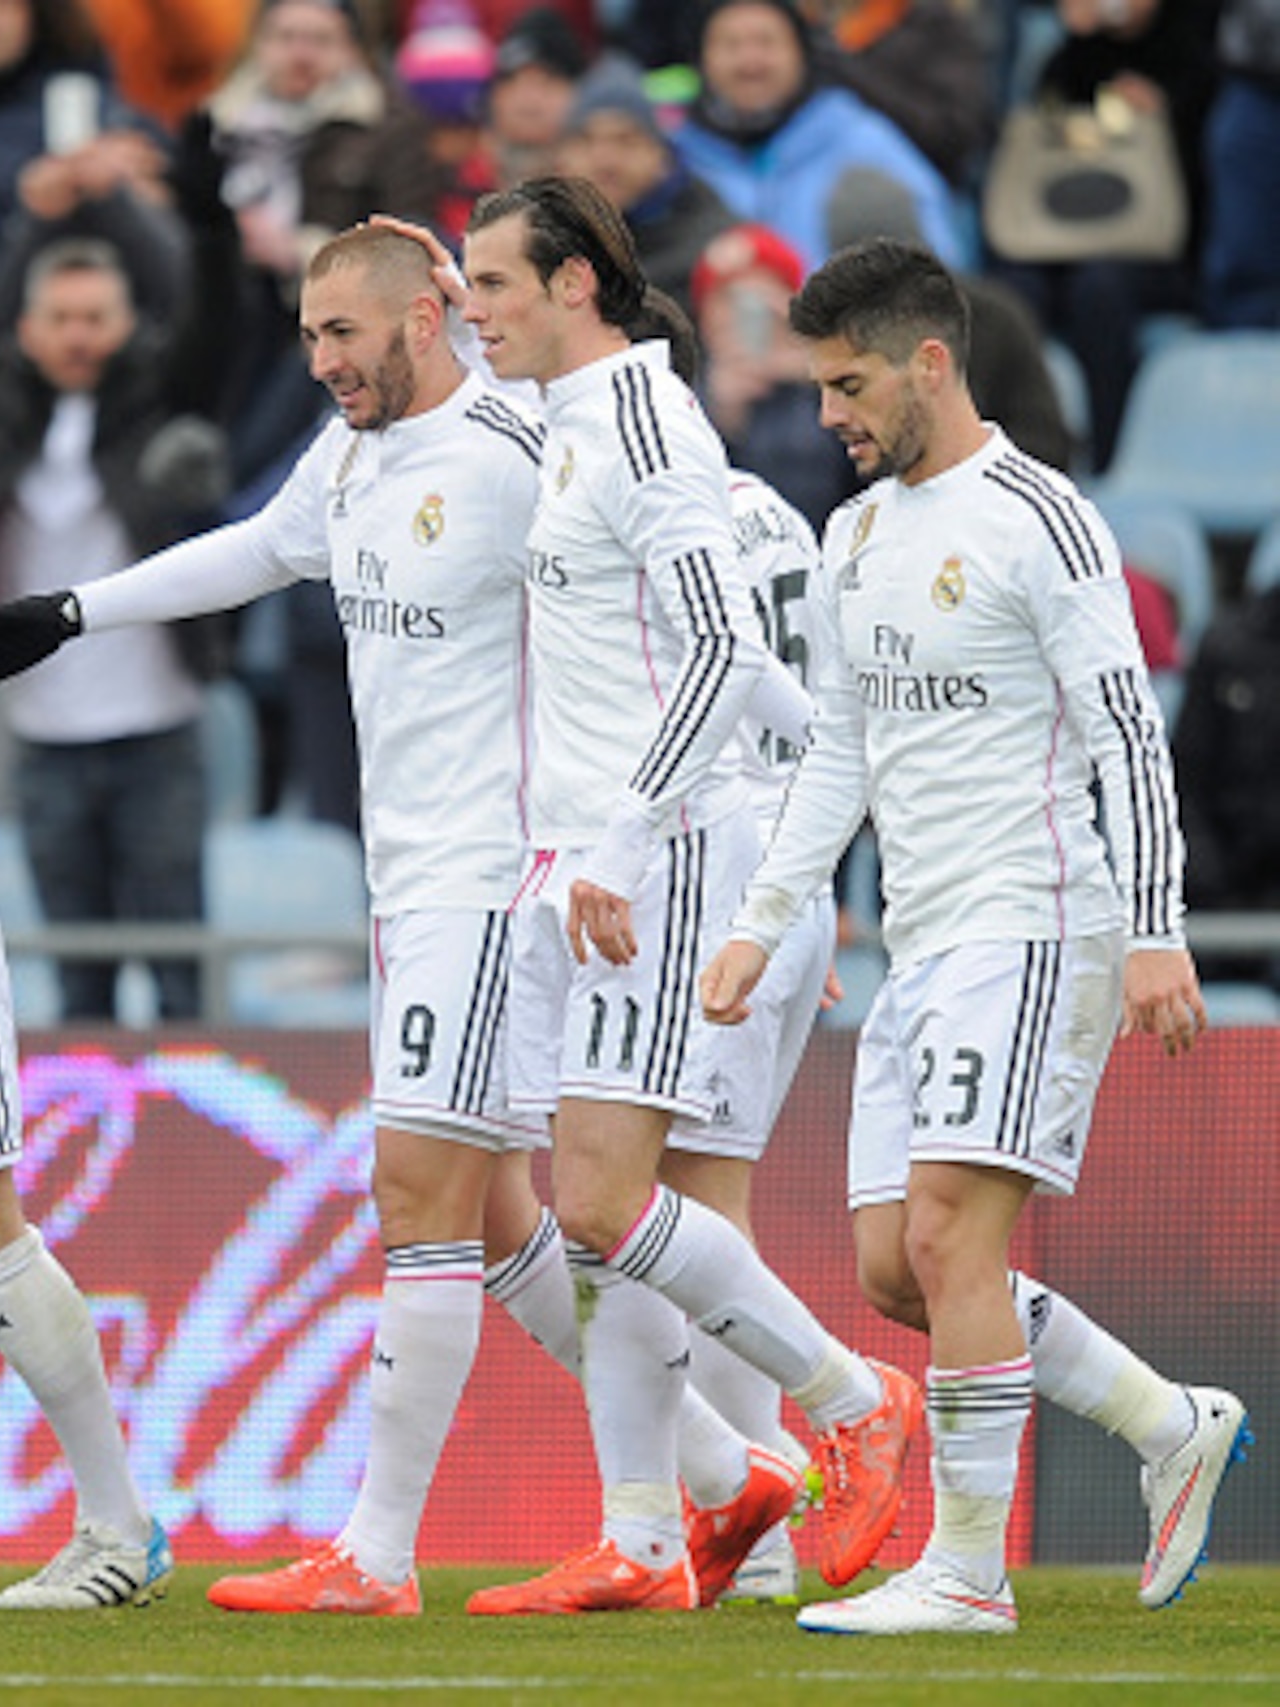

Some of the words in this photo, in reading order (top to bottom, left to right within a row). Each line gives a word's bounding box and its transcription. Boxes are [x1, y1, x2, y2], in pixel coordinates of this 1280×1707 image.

[356, 549, 389, 591] Fly
[874, 624, 915, 666] Fly
[849, 662, 989, 712] mirates
[401, 1004, 435, 1078] 9
[586, 990, 641, 1071] 11
[913, 1047, 984, 1127] 23
